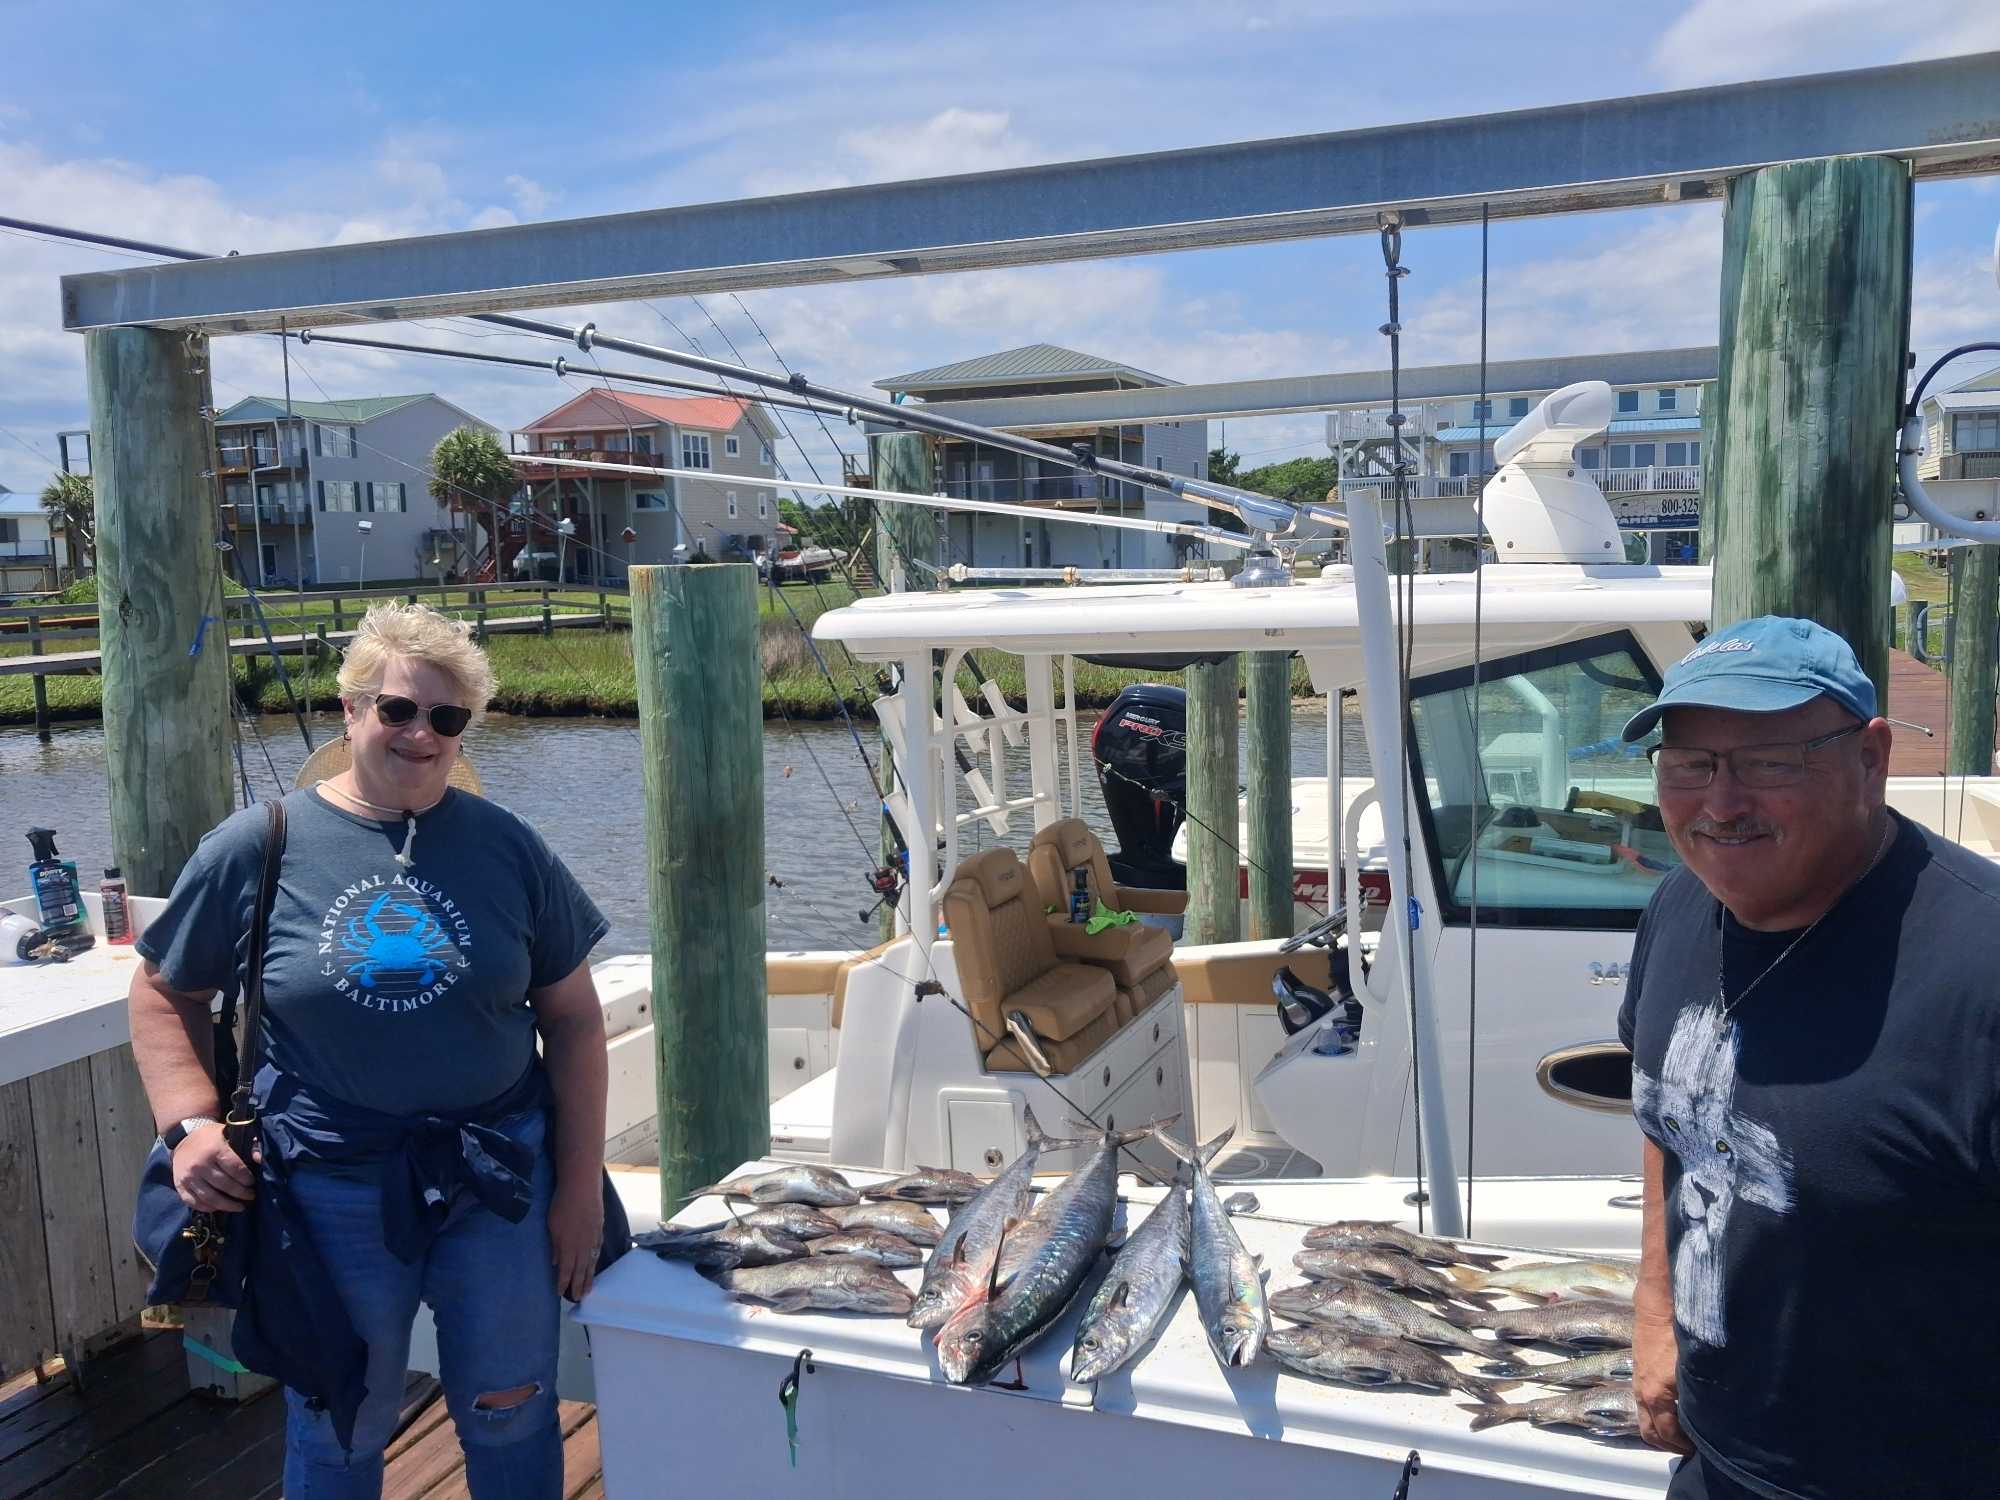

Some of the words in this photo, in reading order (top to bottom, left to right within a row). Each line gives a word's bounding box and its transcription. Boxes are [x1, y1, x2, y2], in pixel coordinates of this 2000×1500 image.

[1119, 718, 1163, 737] PRO
[1125, 711, 1160, 726] MERCURY
[318, 874, 385, 957] NATIONAL
[391, 873, 472, 947] AQUARIUM
[334, 971, 458, 1013] BALTIMORE
